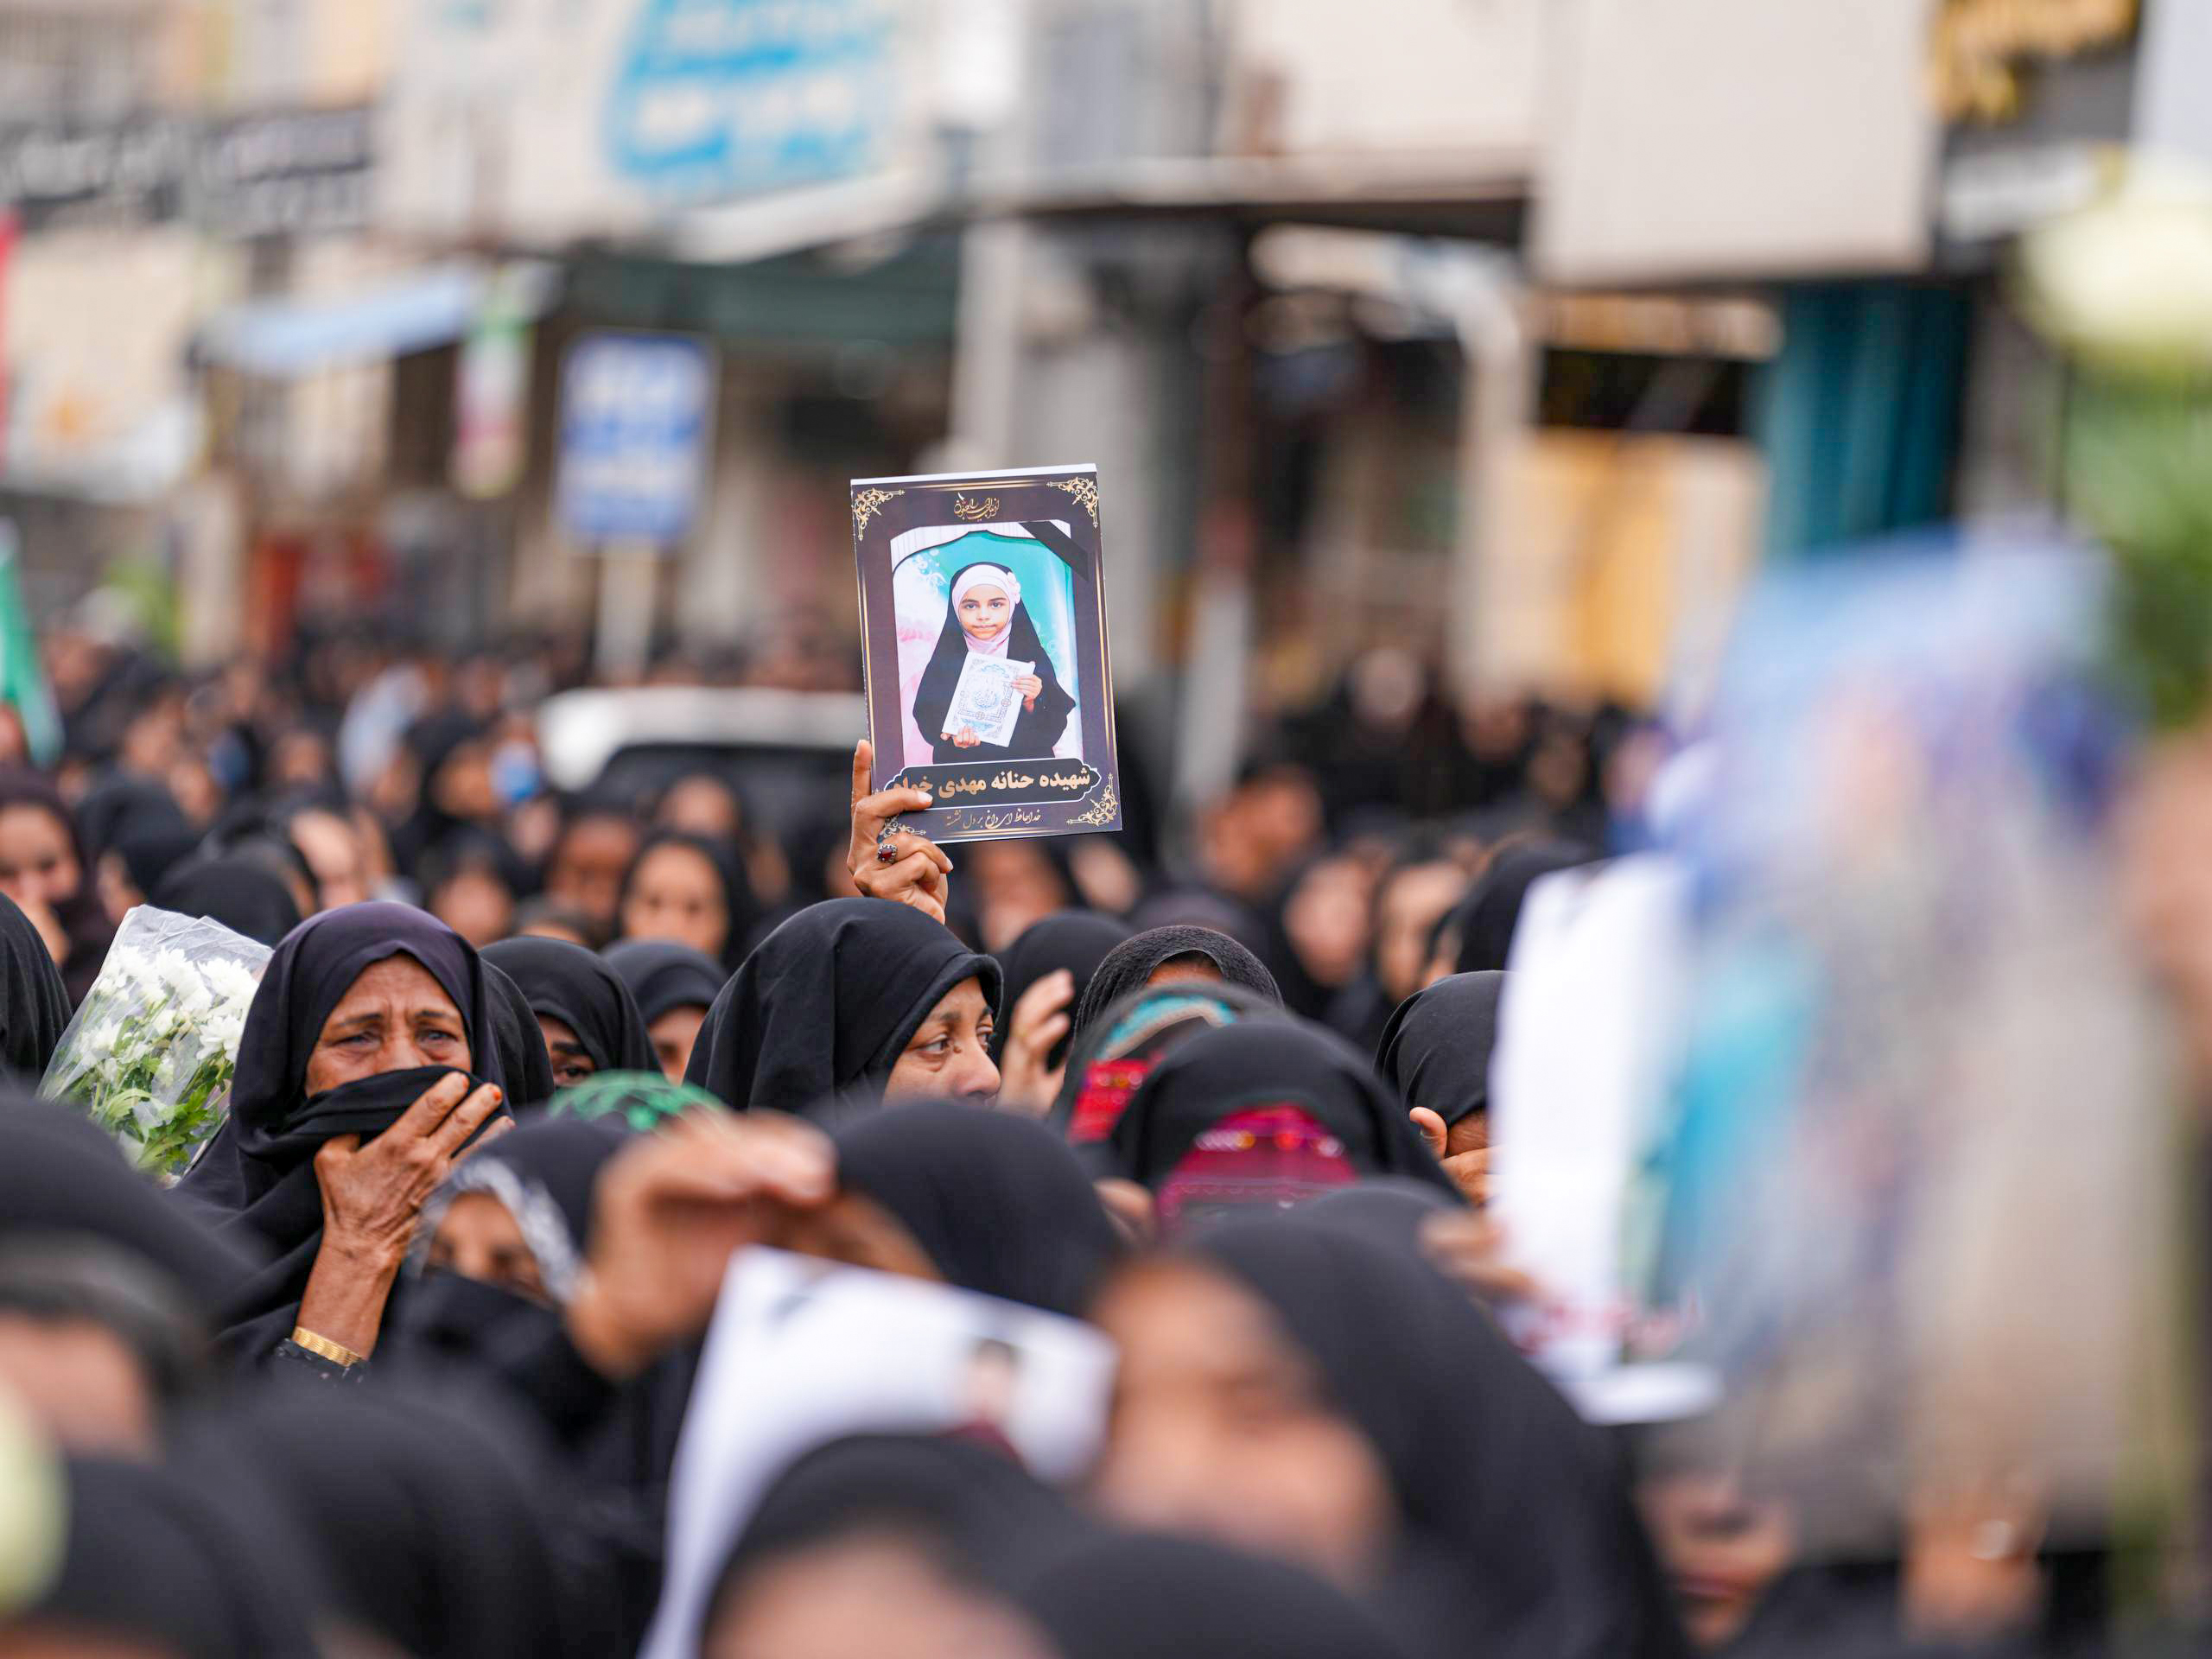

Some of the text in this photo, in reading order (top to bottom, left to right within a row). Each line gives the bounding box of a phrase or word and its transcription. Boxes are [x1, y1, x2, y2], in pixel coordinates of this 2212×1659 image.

[938, 777, 987, 799] مهدی
[990, 770, 1034, 790] حنانه
[1039, 767, 1090, 791] شهیده
[1014, 808, 1042, 824] خداحافظ
